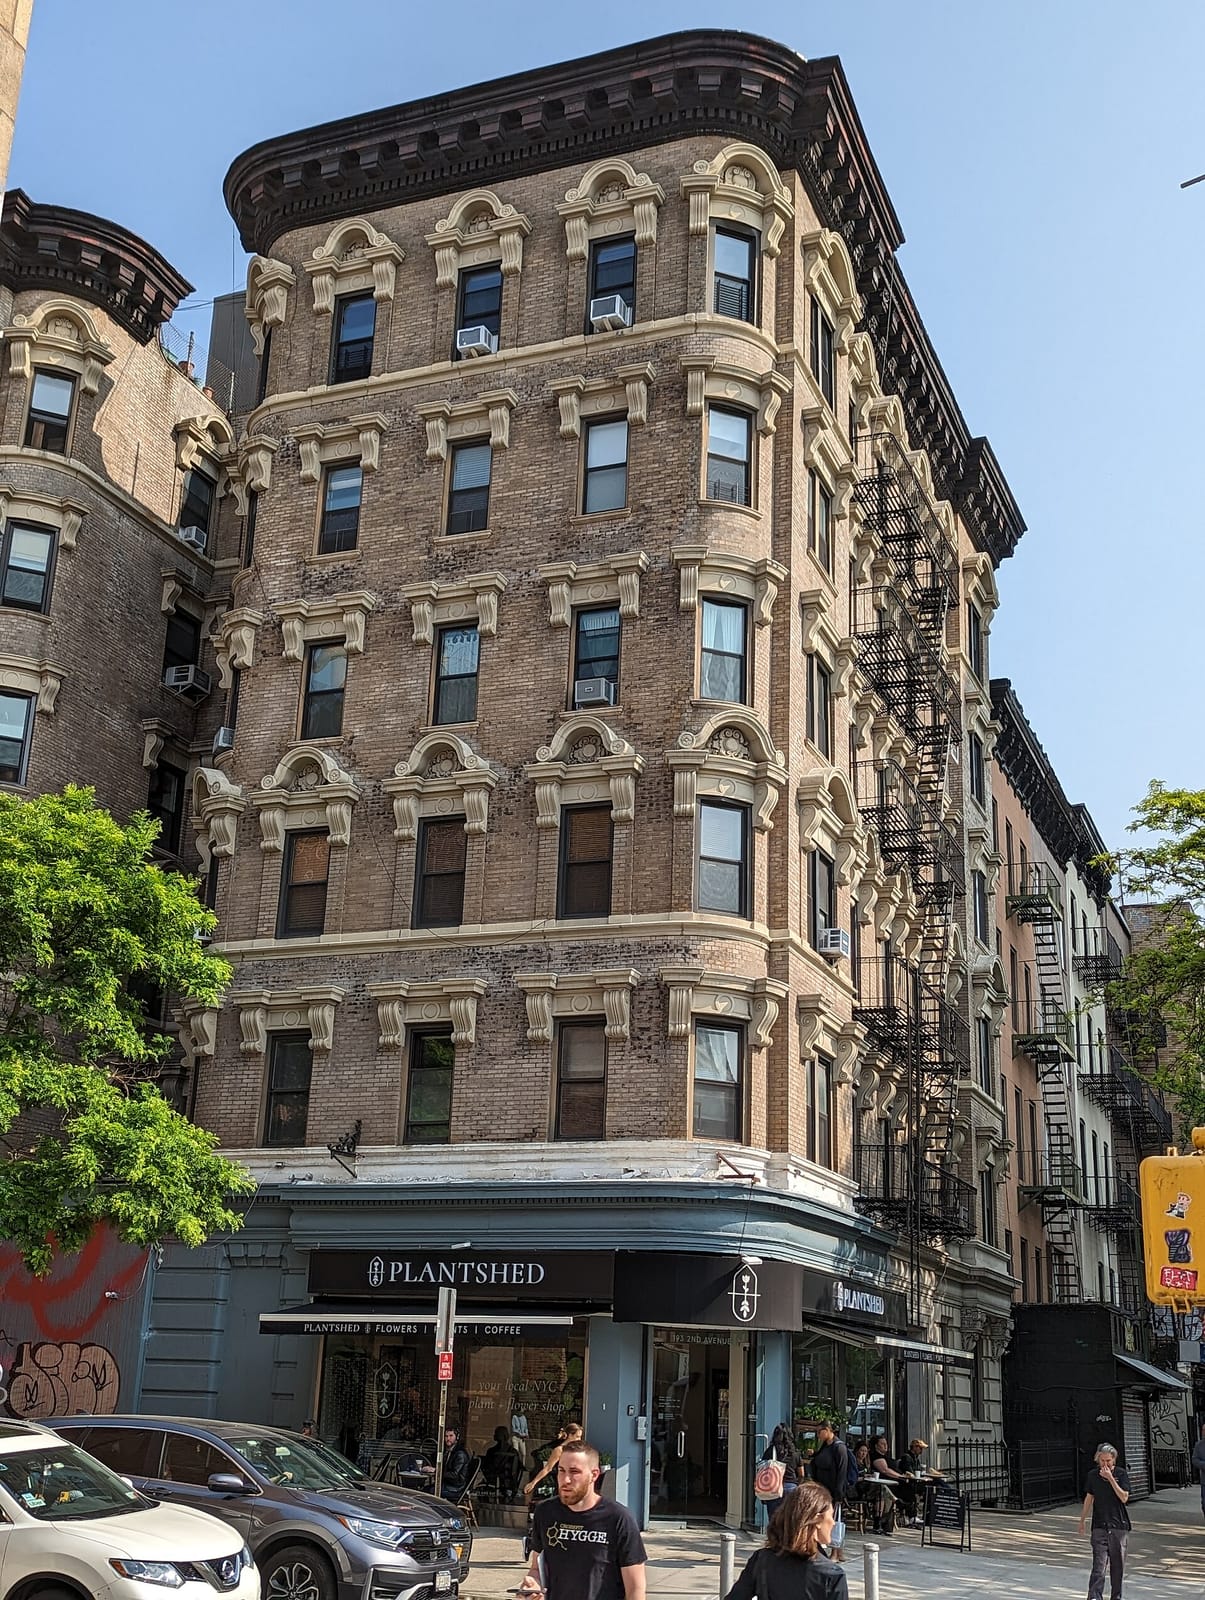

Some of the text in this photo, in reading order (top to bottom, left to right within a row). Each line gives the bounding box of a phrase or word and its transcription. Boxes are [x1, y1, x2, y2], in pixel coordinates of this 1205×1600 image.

[388, 1261, 545, 1284] PLANTSHED
[843, 1288, 885, 1315] PLANTSHED
[304, 1323, 360, 1332] PLANTSHED
[375, 1324, 418, 1334] FLOWERS
[484, 1325, 521, 1335] COFFEE
[687, 1335, 701, 1343] 2ND
[703, 1336, 731, 1345] AVENUE
[479, 1378, 558, 1392] your local NYC
[468, 1396, 496, 1412] plant
[505, 1396, 540, 1414] flower
[541, 1398, 565, 1415] shop
